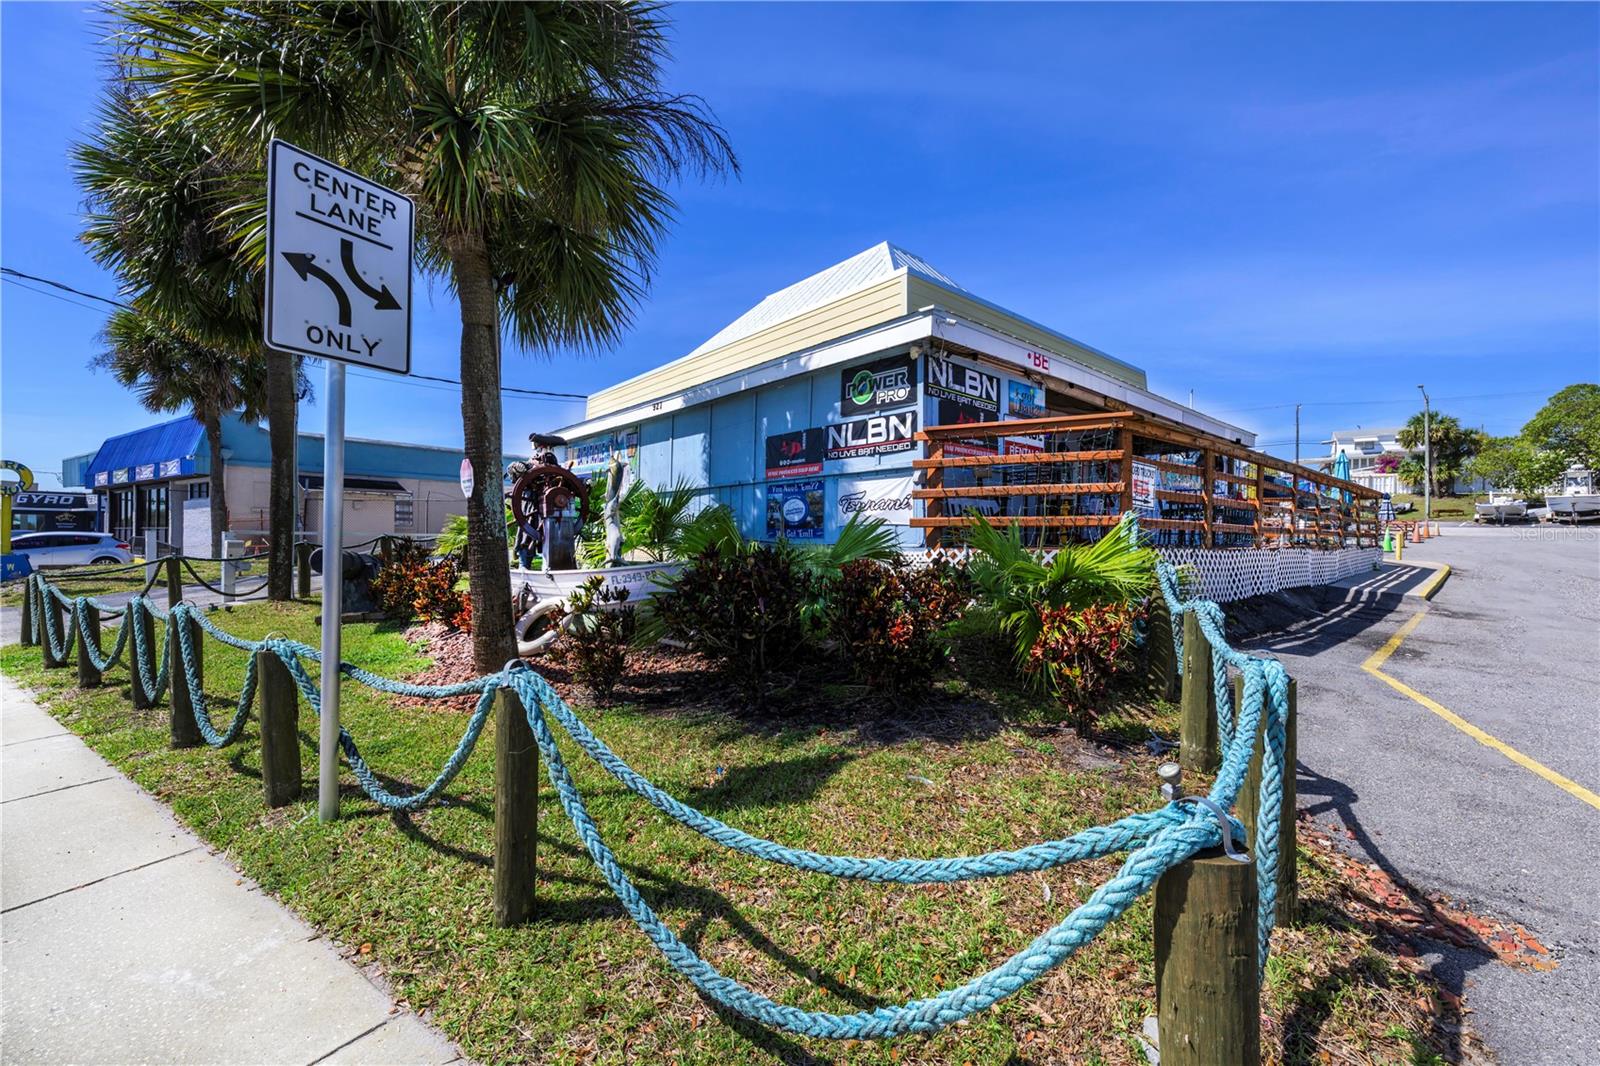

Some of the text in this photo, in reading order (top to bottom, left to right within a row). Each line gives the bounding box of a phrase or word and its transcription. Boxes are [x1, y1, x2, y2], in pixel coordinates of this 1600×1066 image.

[293, 161, 397, 220] CENTER
[311, 194, 381, 237] LANE
[306, 325, 382, 357] ONLY
[845, 367, 908, 405] POWER
[876, 386, 910, 404] PRO
[928, 357, 998, 402] NLBN
[972, 400, 998, 412] NEEDED
[828, 412, 913, 450] NLBN
[828, 451, 838, 459] NO
[839, 449, 856, 458] LIVE
[876, 442, 911, 454] NEEDED
[838, 490, 912, 515] Tsunami
